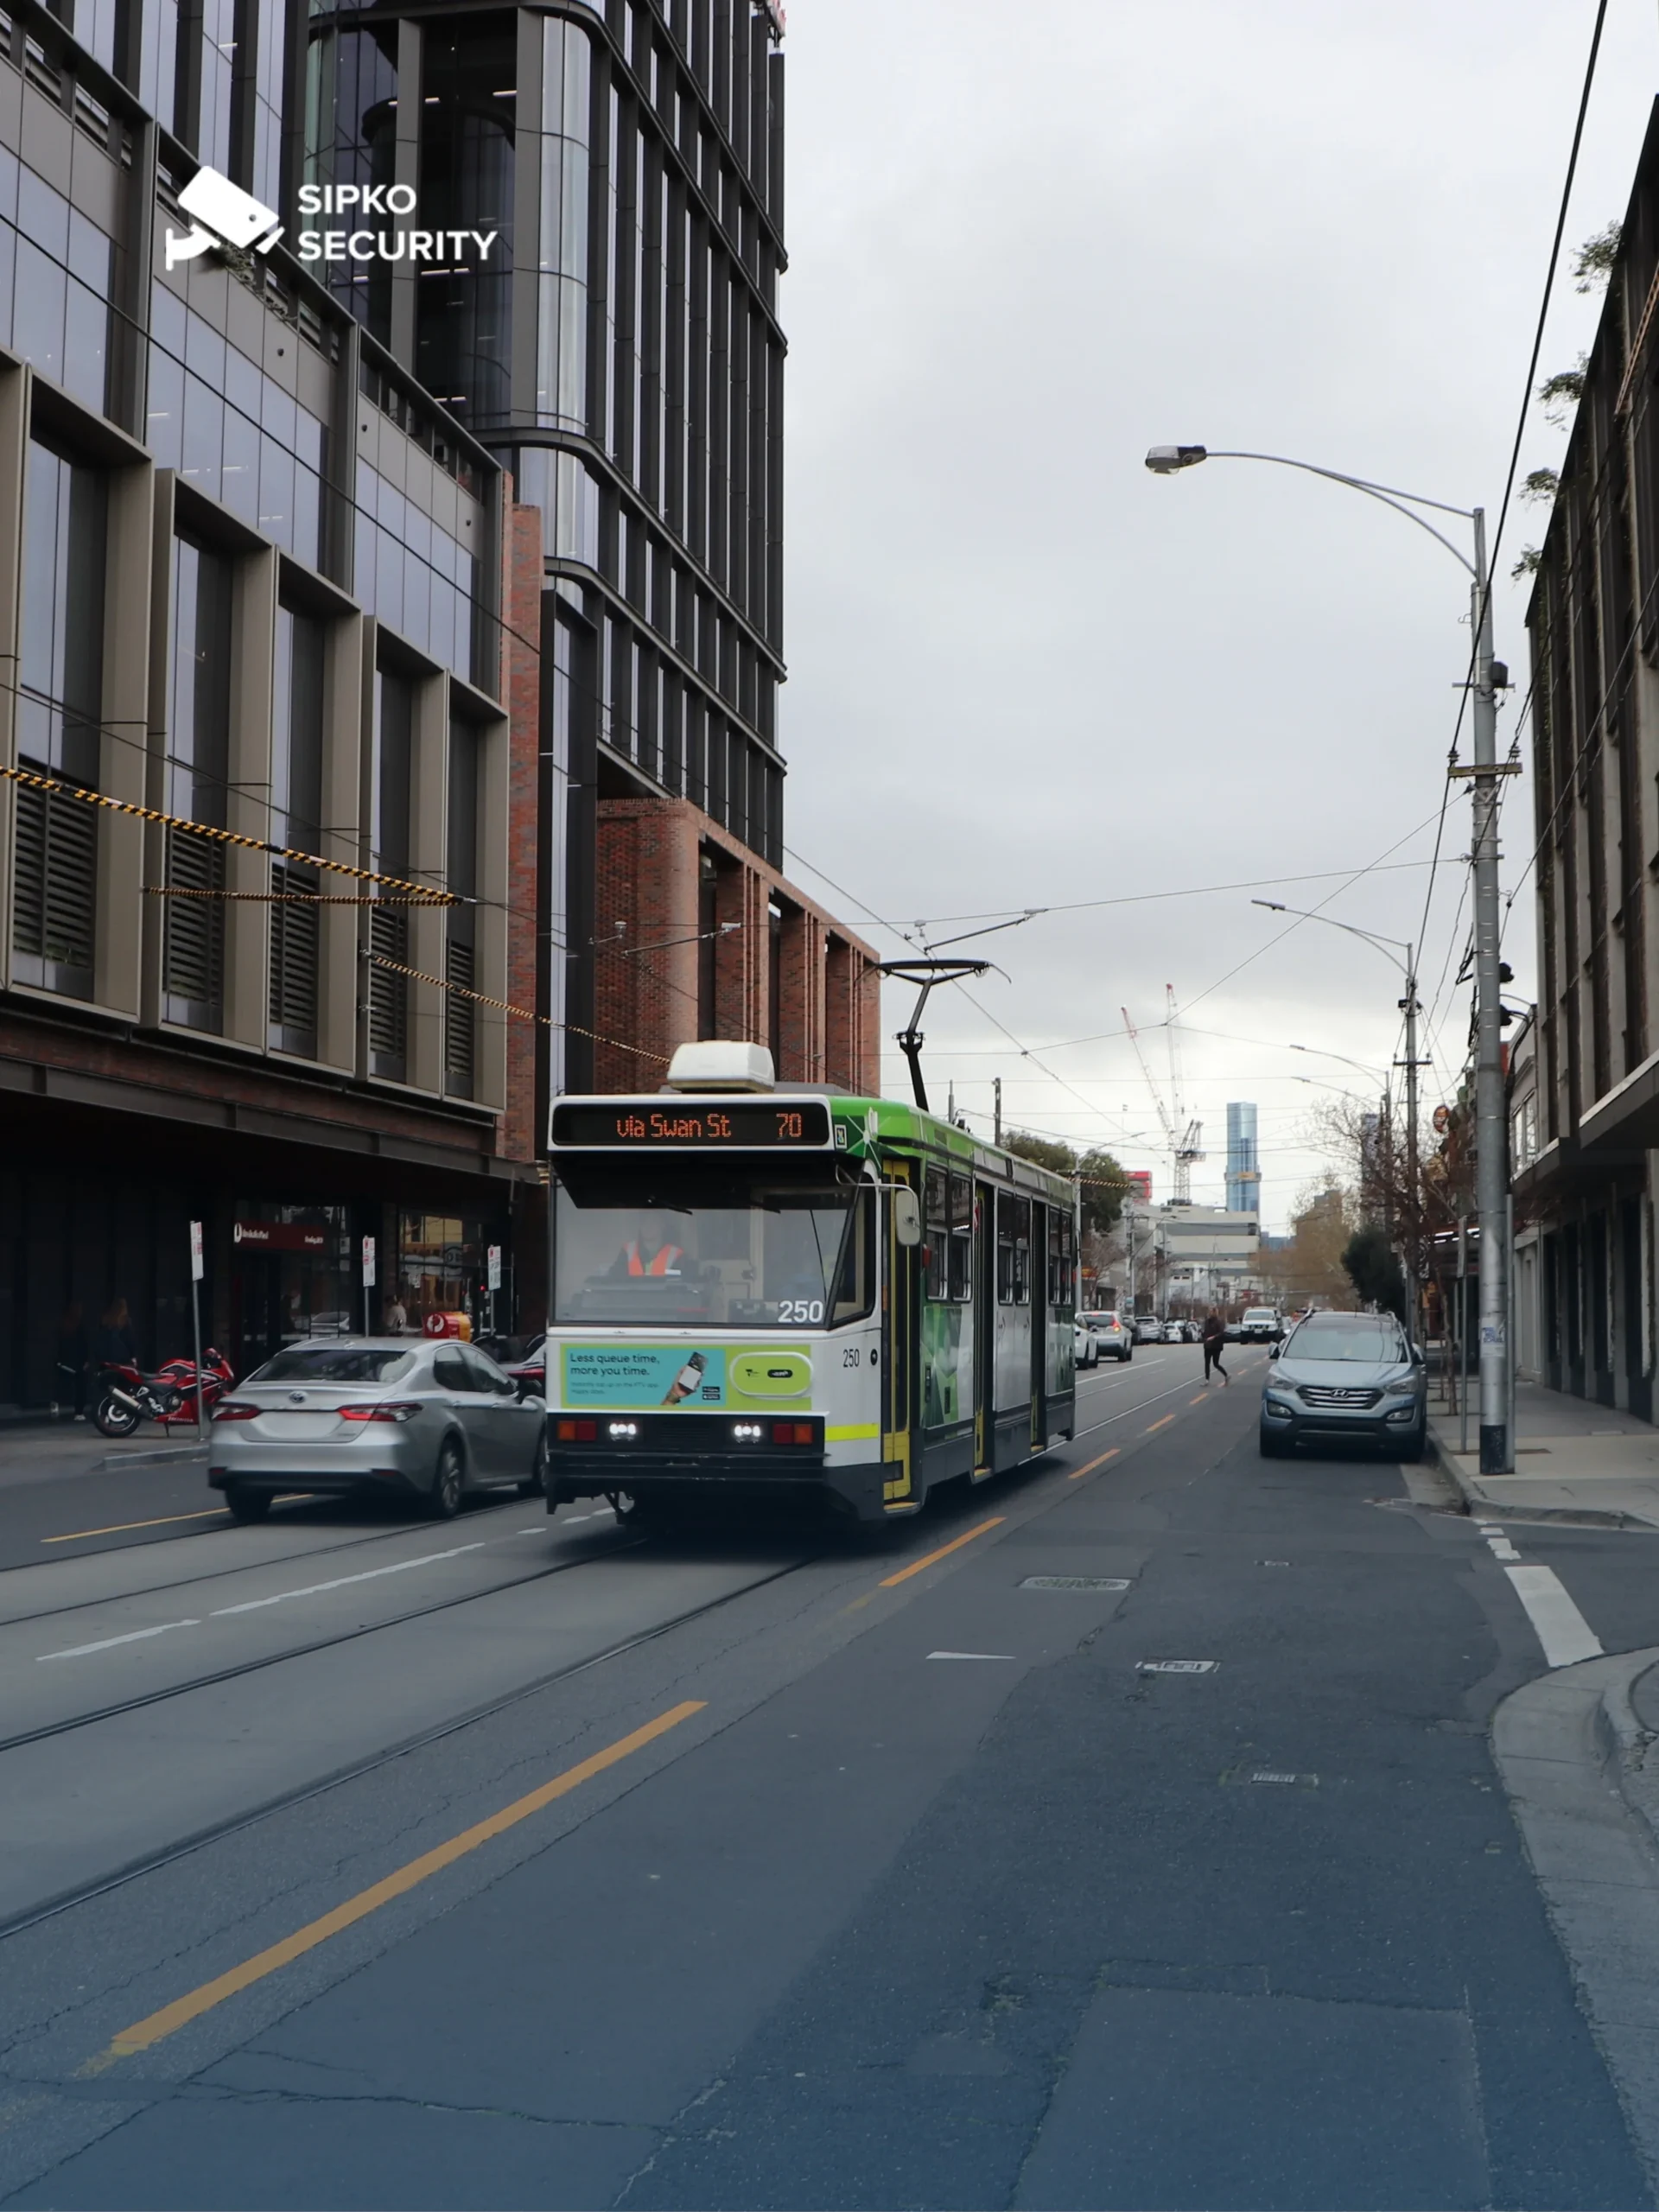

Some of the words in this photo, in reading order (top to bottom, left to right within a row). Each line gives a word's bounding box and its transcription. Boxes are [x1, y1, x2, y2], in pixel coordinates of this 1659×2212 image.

[617, 1116, 645, 1137] via
[650, 1114, 701, 1137] Swan
[707, 1114, 731, 1137] St
[776, 1114, 802, 1137] 70
[778, 1300, 823, 1323] 250
[570, 1353, 594, 1363] Less
[598, 1355, 630, 1364] queue
[632, 1354, 660, 1364] time,
[842, 1349, 860, 1368] 250
[570, 1367, 598, 1376] more
[601, 1368, 621, 1377] you
[623, 1367, 650, 1376] time.
